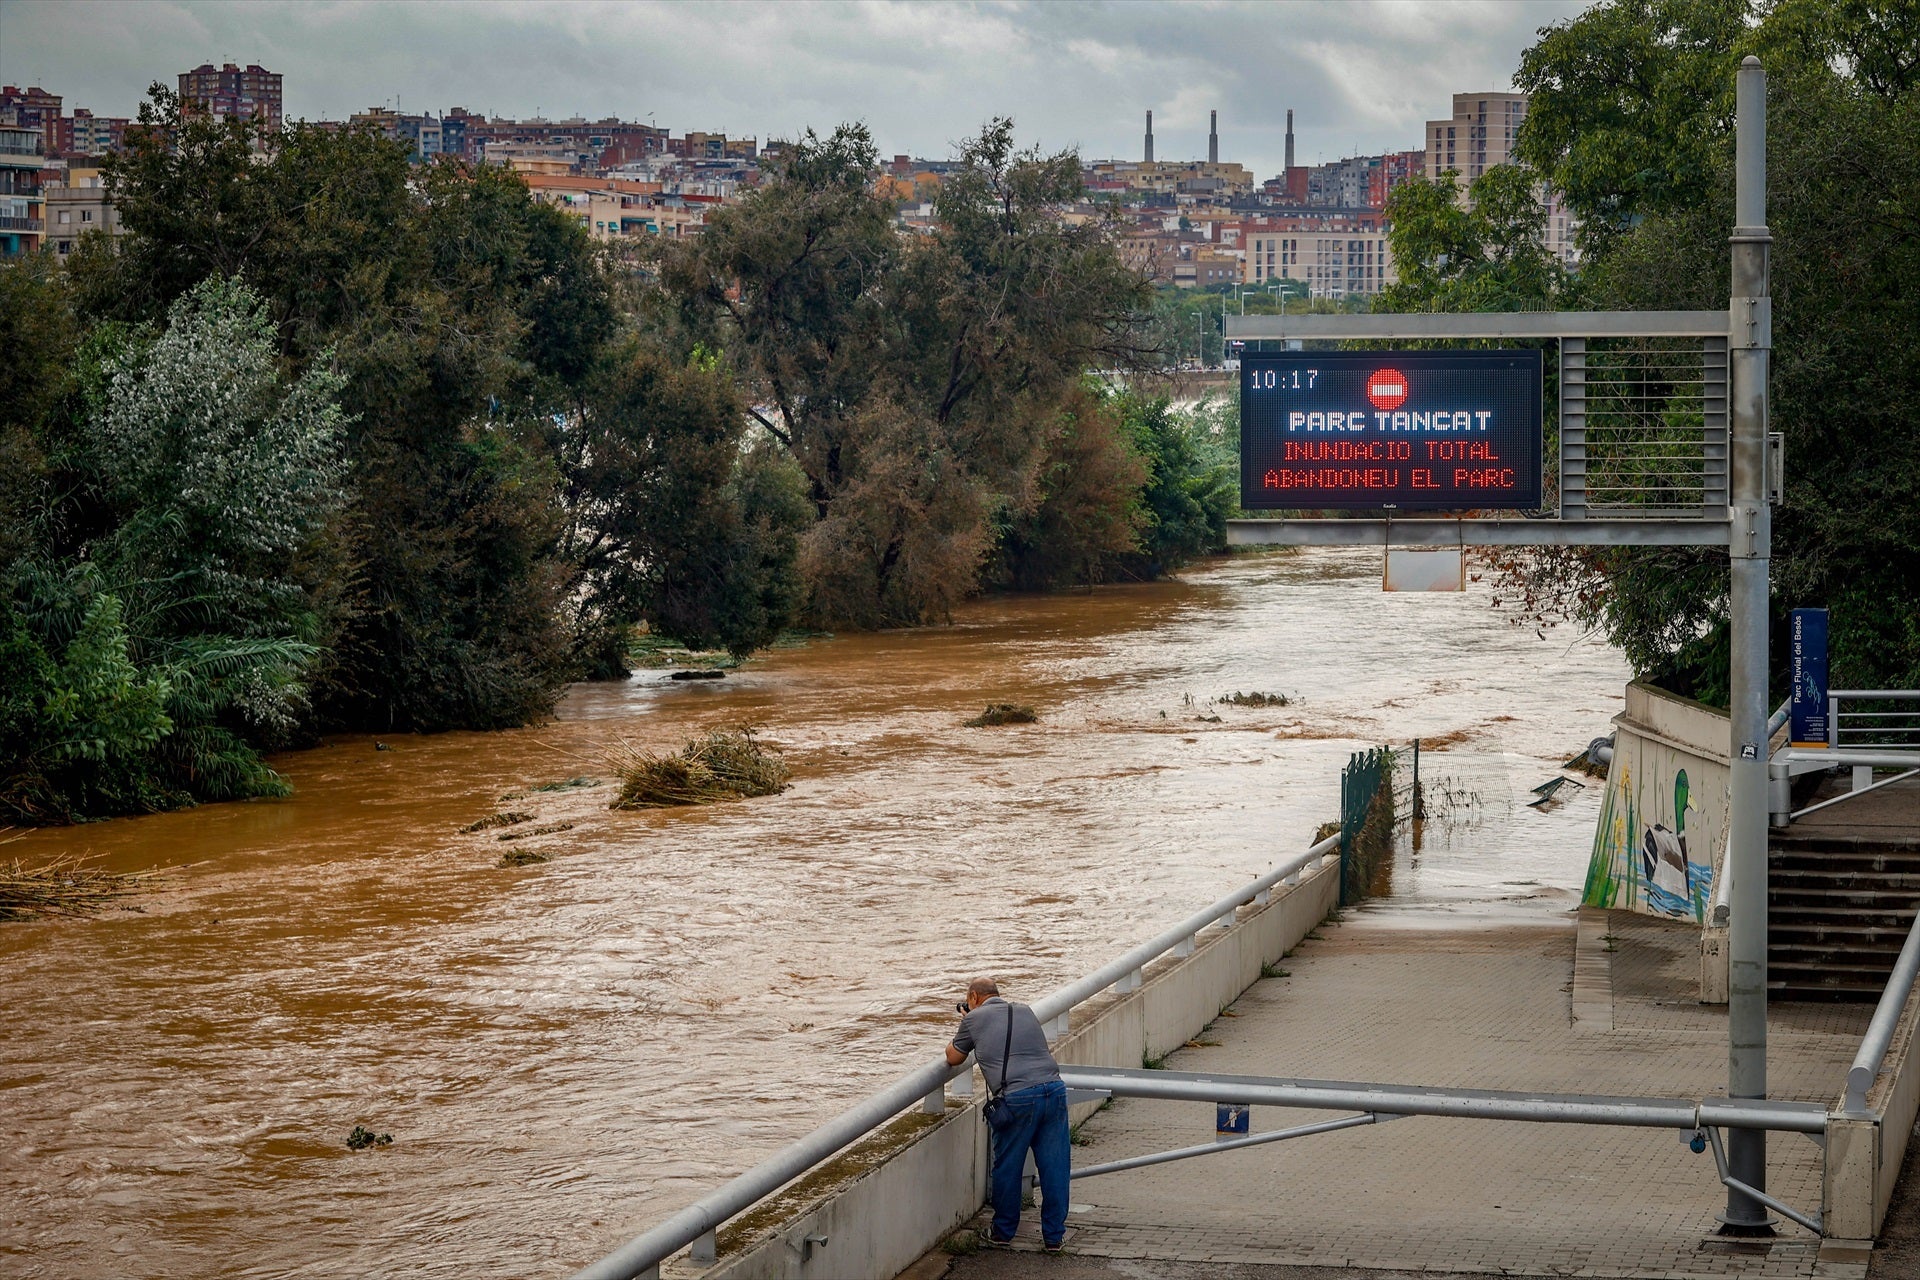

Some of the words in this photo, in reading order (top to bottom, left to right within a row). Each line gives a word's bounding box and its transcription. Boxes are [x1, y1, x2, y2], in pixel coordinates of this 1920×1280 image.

[1252, 369, 1318, 389] 10:17
[1289, 411, 1365, 431] PARC
[1374, 411, 1491, 431] TANCAT
[1284, 441, 1411, 461] INUNDACIO
[1425, 441, 1499, 461] TOTAL
[1264, 468, 1398, 488] ABANDONEU
[1412, 468, 1441, 488] EL
[1454, 468, 1514, 488] PARC
[1794, 642, 1802, 655] del
[1794, 656, 1802, 683] Fluvial
[1794, 684, 1802, 703] Parc
